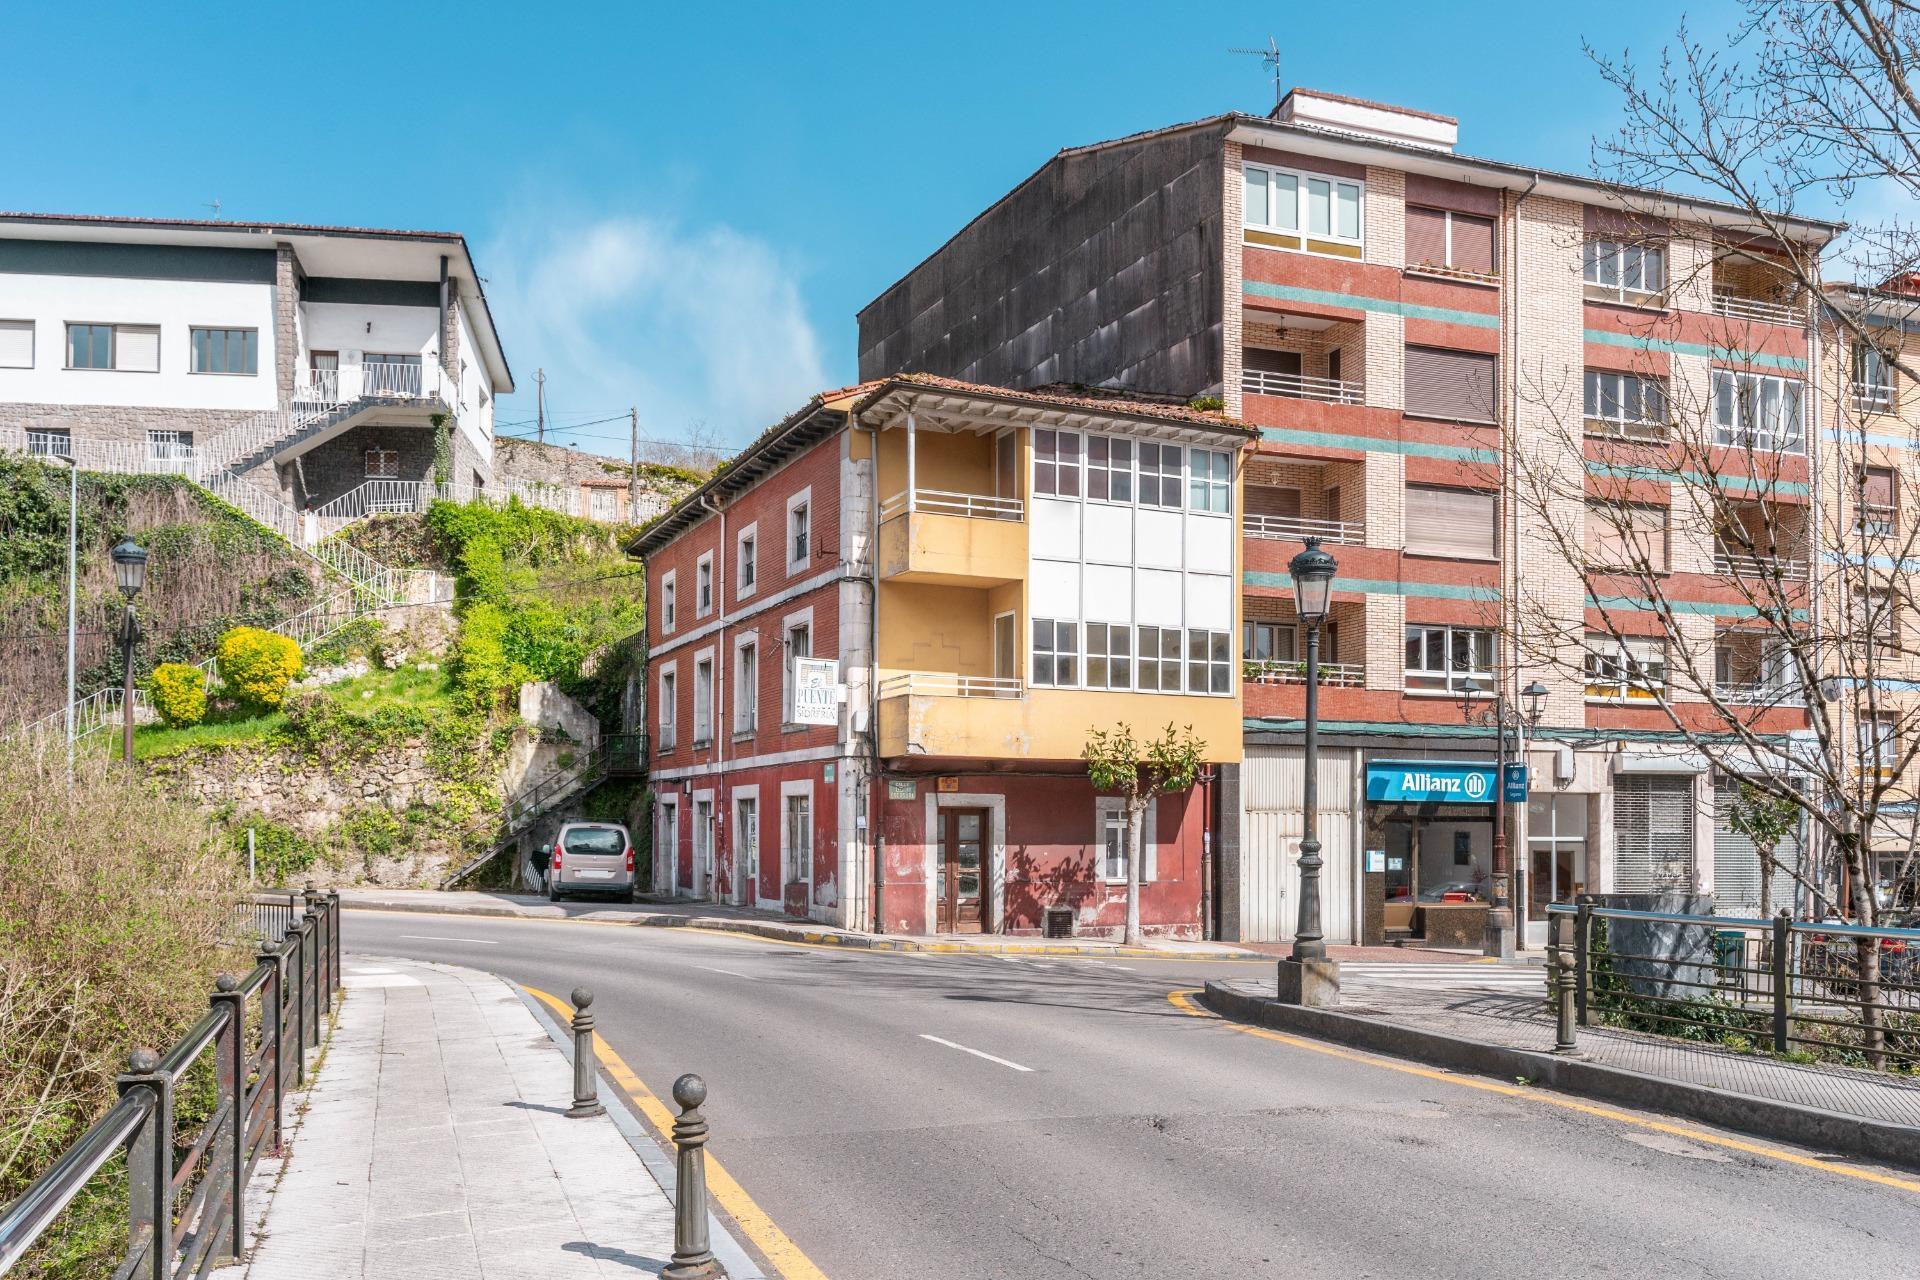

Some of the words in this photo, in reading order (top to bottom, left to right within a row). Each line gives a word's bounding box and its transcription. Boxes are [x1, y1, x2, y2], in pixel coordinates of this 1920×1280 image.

[797, 689, 836, 705] PUENTE
[1402, 772, 1461, 792] Allianz
[1506, 781, 1525, 790] Allianz
